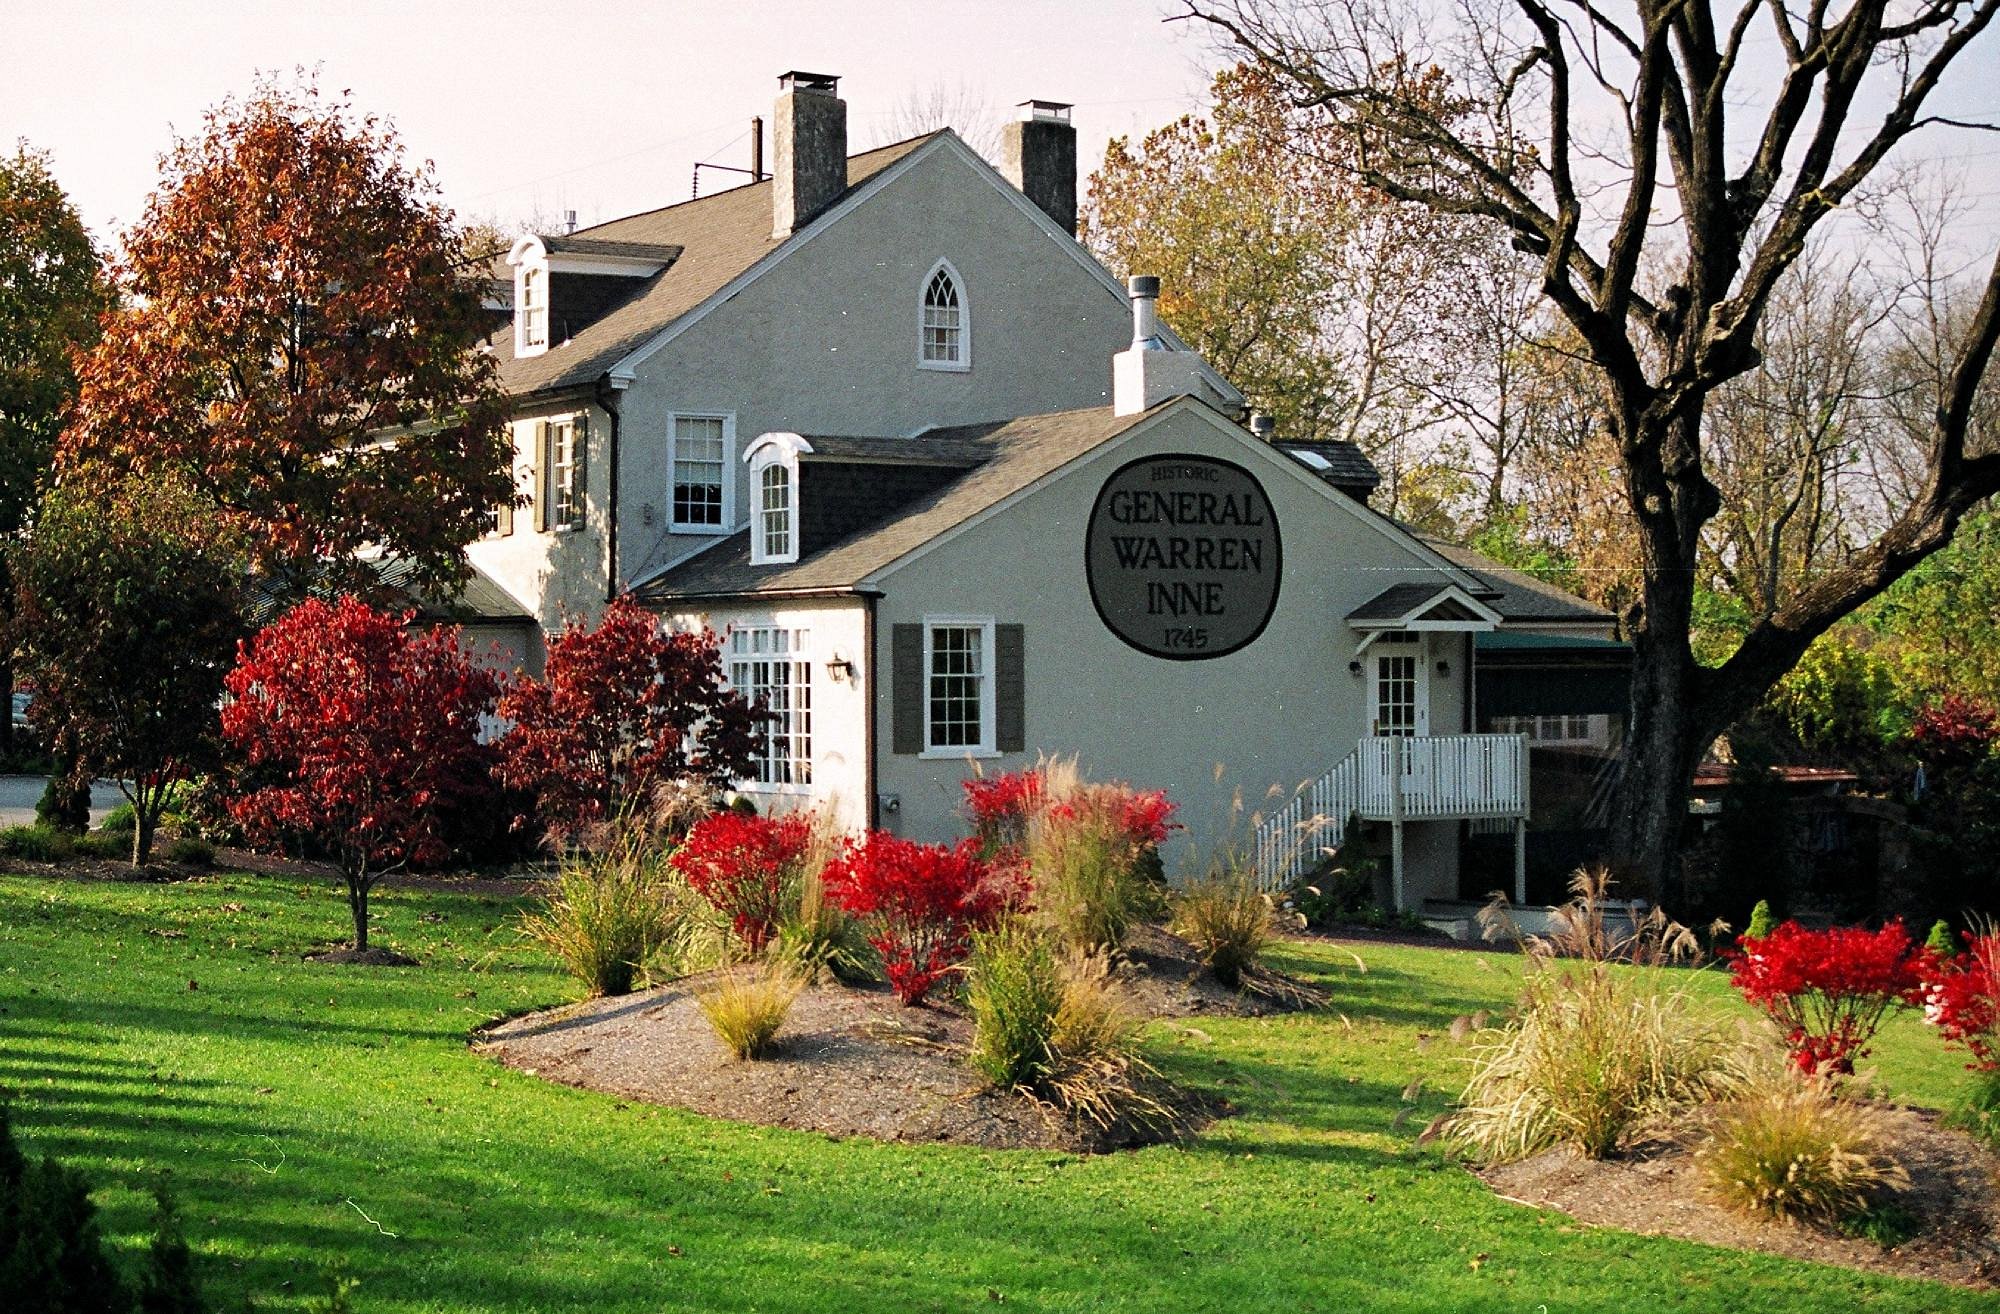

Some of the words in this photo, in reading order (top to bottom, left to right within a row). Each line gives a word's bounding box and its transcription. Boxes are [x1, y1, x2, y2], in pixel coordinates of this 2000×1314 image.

[1151, 465, 1219, 483] HISTORIC
[1109, 490, 1264, 526] GENERAL
[1110, 536, 1263, 573] WARREN
[1147, 582, 1225, 617] INNE
[1164, 628, 1209, 648] 1745
